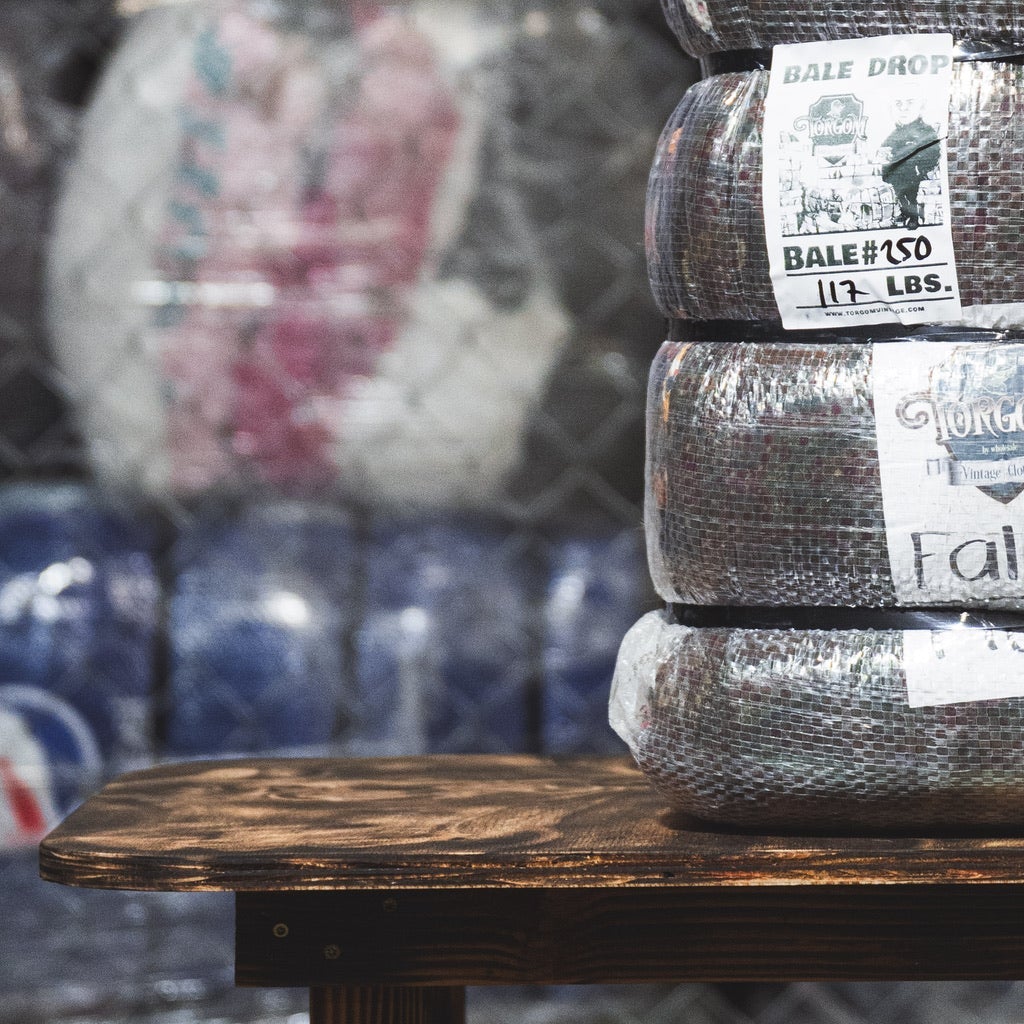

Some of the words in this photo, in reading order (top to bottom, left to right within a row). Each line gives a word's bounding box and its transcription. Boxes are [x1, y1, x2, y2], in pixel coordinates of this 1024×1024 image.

[783, 60, 854, 85] BALE
[868, 54, 949, 77] DROP
[880, 235, 932, 265] 250
[817, 279, 870, 308] 117
[886, 273, 953, 296] LBS.
[825, 306, 925, 317] WWW.TORGOMVINGE.COM
[960, 463, 1001, 482] Vintage
